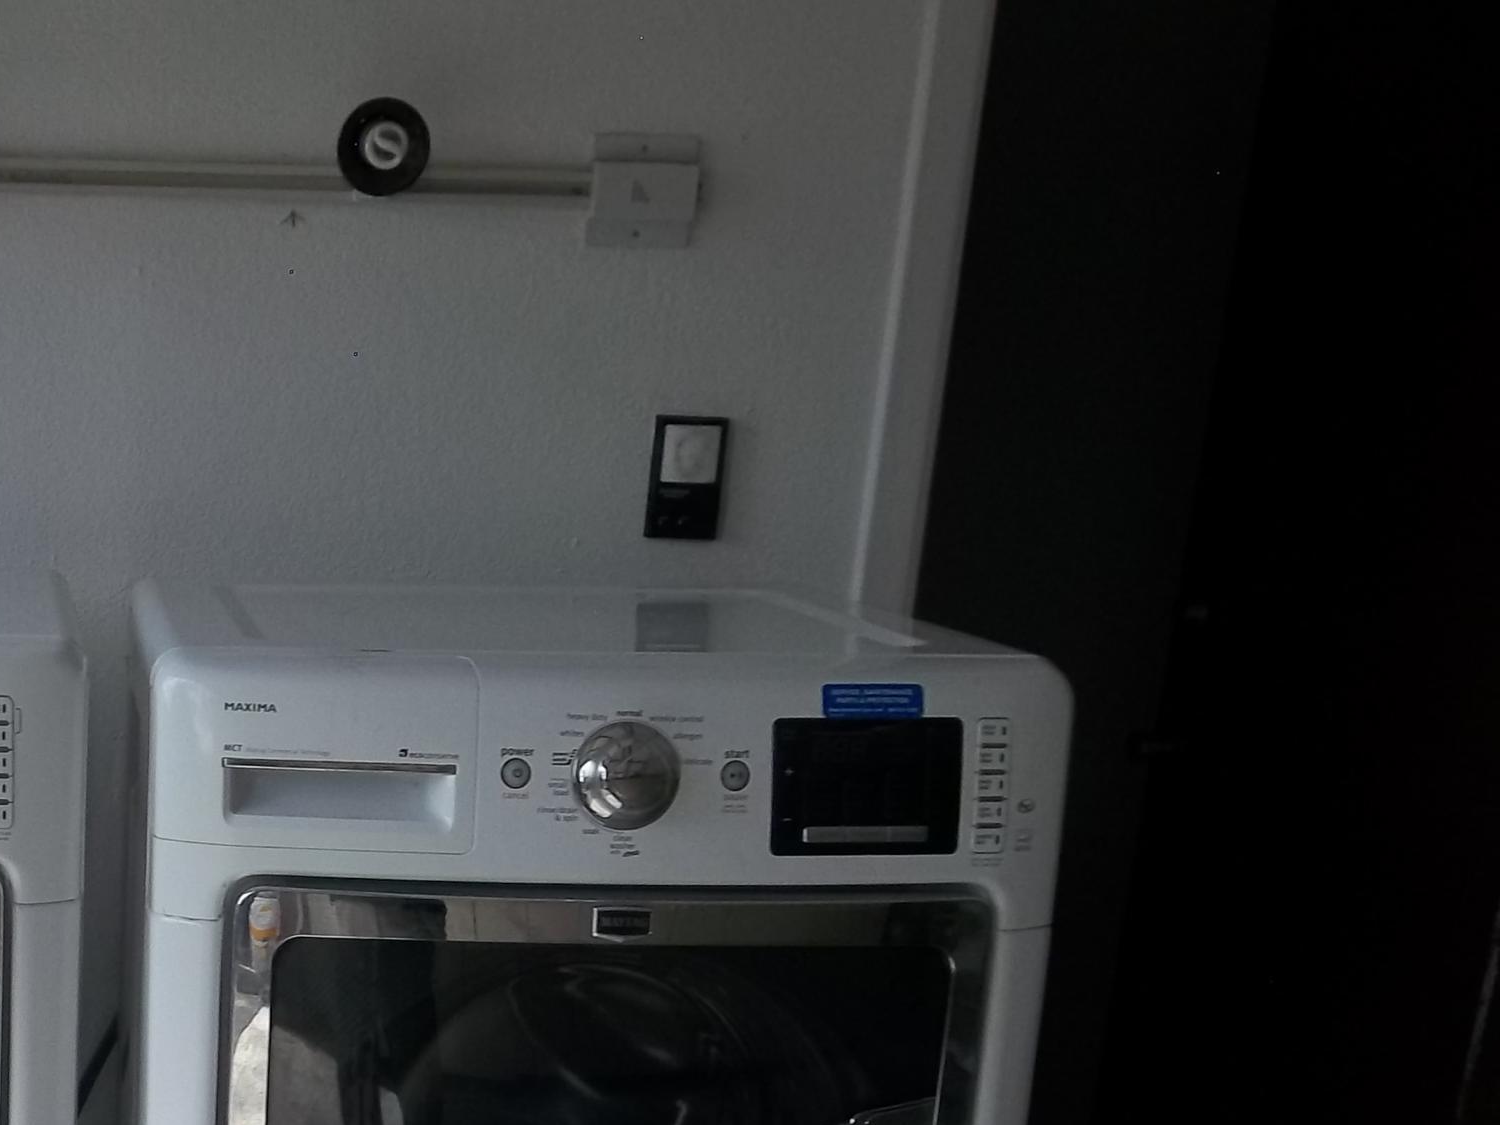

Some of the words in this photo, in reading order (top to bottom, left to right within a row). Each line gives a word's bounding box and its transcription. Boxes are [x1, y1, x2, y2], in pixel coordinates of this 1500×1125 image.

[224, 702, 277, 713] MAXIMA
[501, 748, 534, 757] power
[724, 750, 749, 759] start
